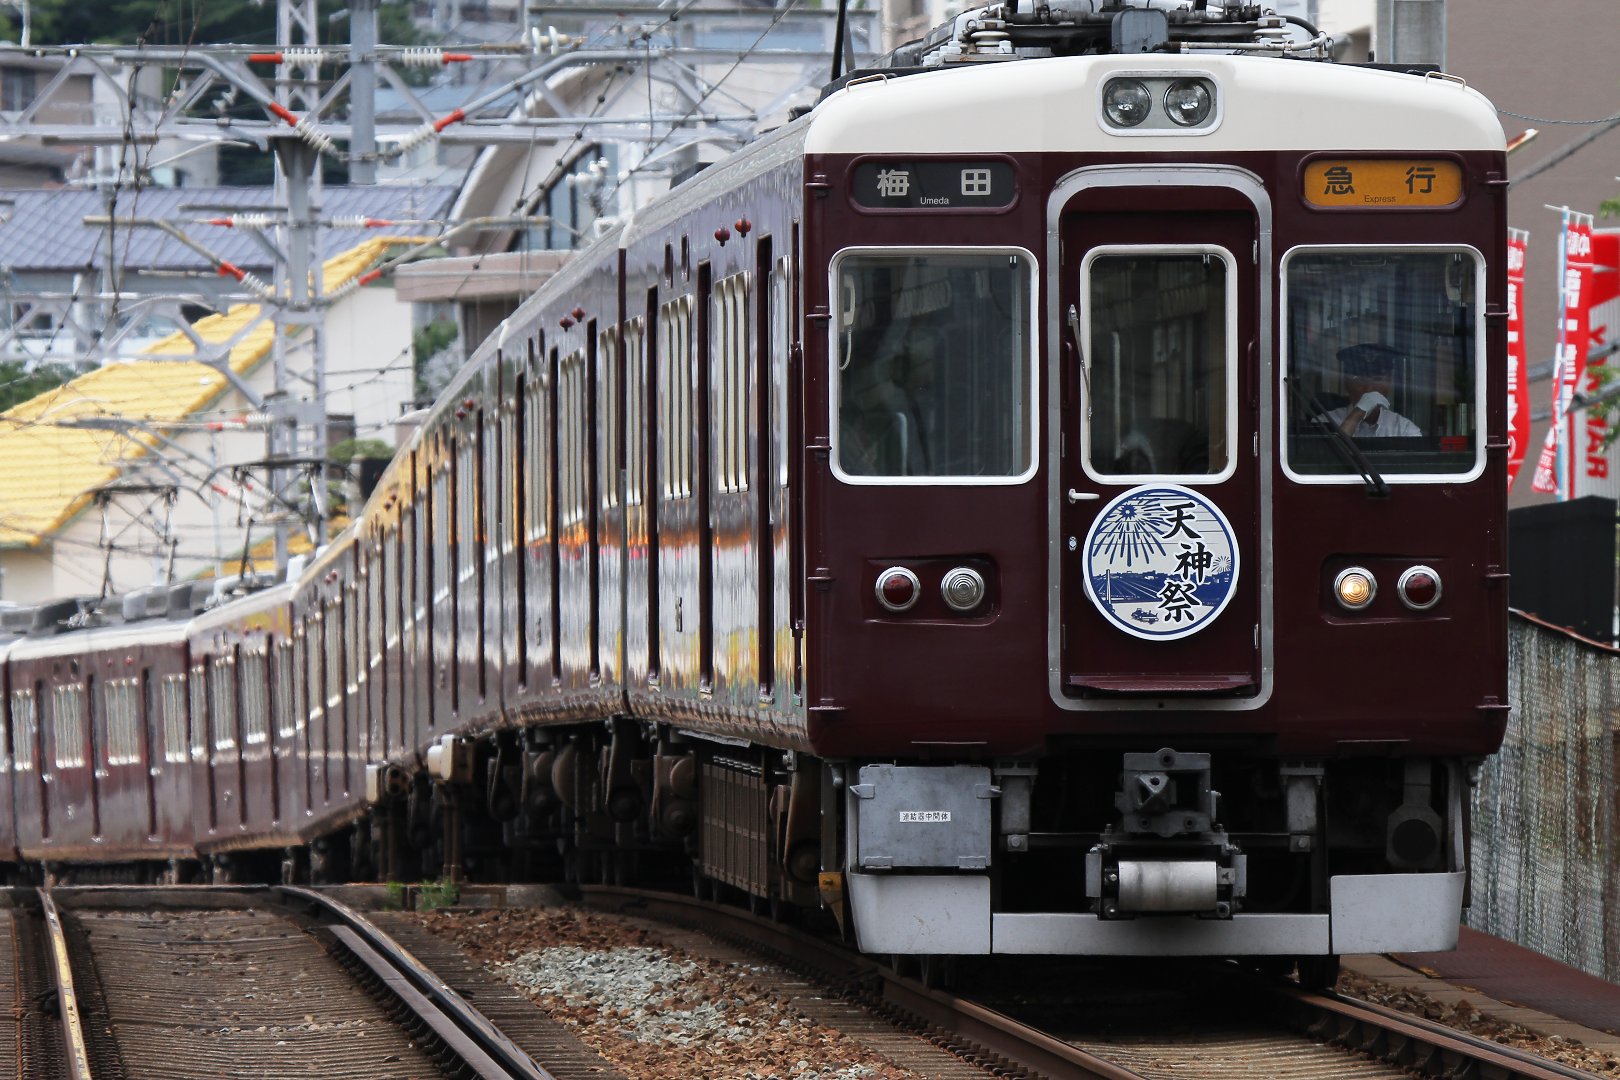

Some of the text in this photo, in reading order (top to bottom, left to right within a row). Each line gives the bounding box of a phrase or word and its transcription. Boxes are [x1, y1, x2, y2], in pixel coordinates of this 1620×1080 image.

[876, 169, 992, 197] 梅田
[1323, 166, 1436, 195] 急行
[919, 196, 950, 206] Umeda
[1363, 195, 1397, 204] Express
[1158, 502, 1214, 622] 天神祭
[902, 811, 949, 822] 連結器中間体
